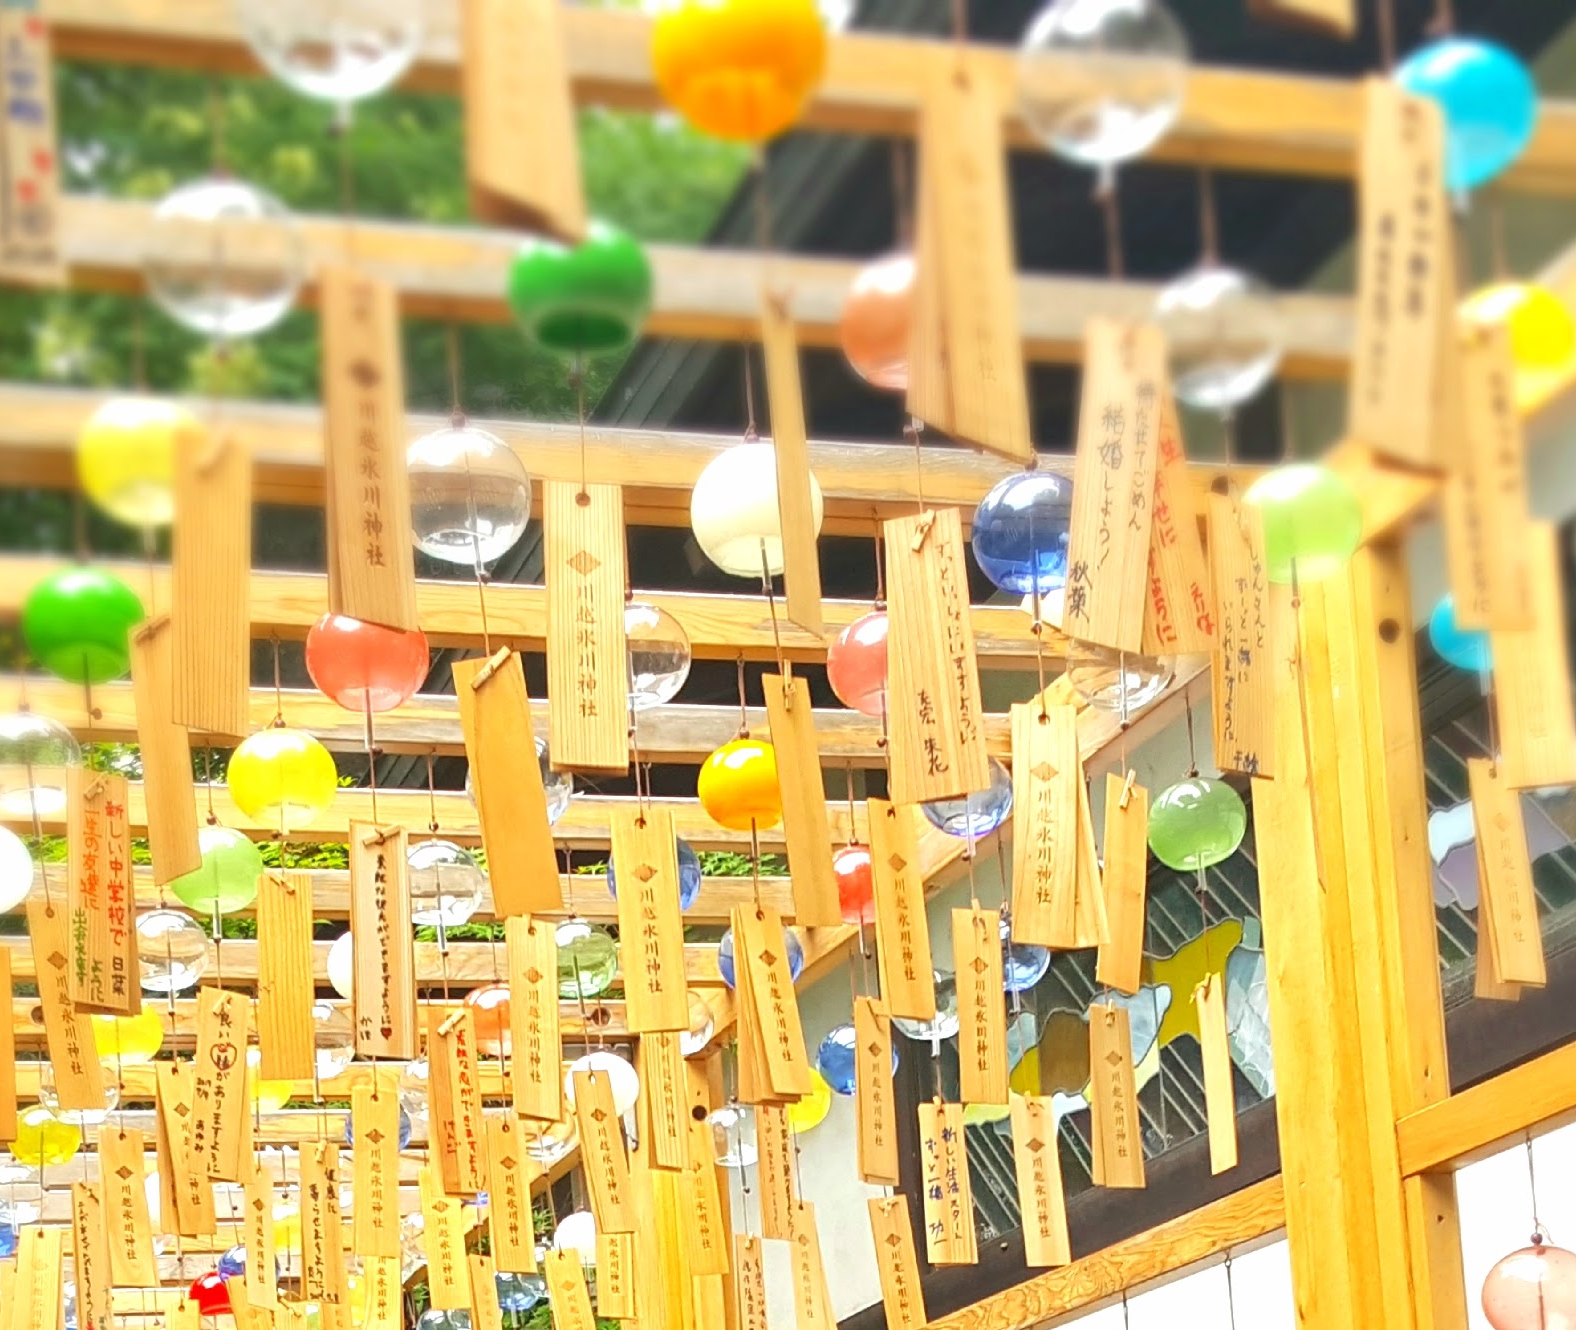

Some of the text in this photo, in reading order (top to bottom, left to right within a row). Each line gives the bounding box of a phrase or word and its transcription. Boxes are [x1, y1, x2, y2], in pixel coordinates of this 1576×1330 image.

[357, 400, 386, 568] 川越氷川神社
[1129, 381, 1157, 531] 待たせてごめん
[576, 583, 598, 718] 川越氷川神社
[106, 801, 126, 947] 新しい中学校で
[1035, 790, 1059, 905] 川越氷川神社
[1497, 838, 1528, 943] 川越氷川神社
[639, 888, 663, 994] 川越氷川神社
[893, 877, 917, 981] 川越氷川神社
[56, 974, 84, 1076] 川越氷川神社
[766, 970, 795, 1064] 川越氷川神社
[974, 978, 990, 1072] 川越氷川神社
[871, 1061, 884, 1147] 川越氷川神社
[1111, 1070, 1129, 1159] 川越氷川神社
[370, 1148, 385, 1230] 川越氷川神社
[504, 1173, 521, 1248] 川越氷川神社
[597, 1124, 620, 1206] 川越氷川神社
[1030, 1157, 1051, 1239] 川越氷川神社
[121, 1184, 137, 1261] 川越氷川神社
[890, 1250, 912, 1324] 川越氷川神社
